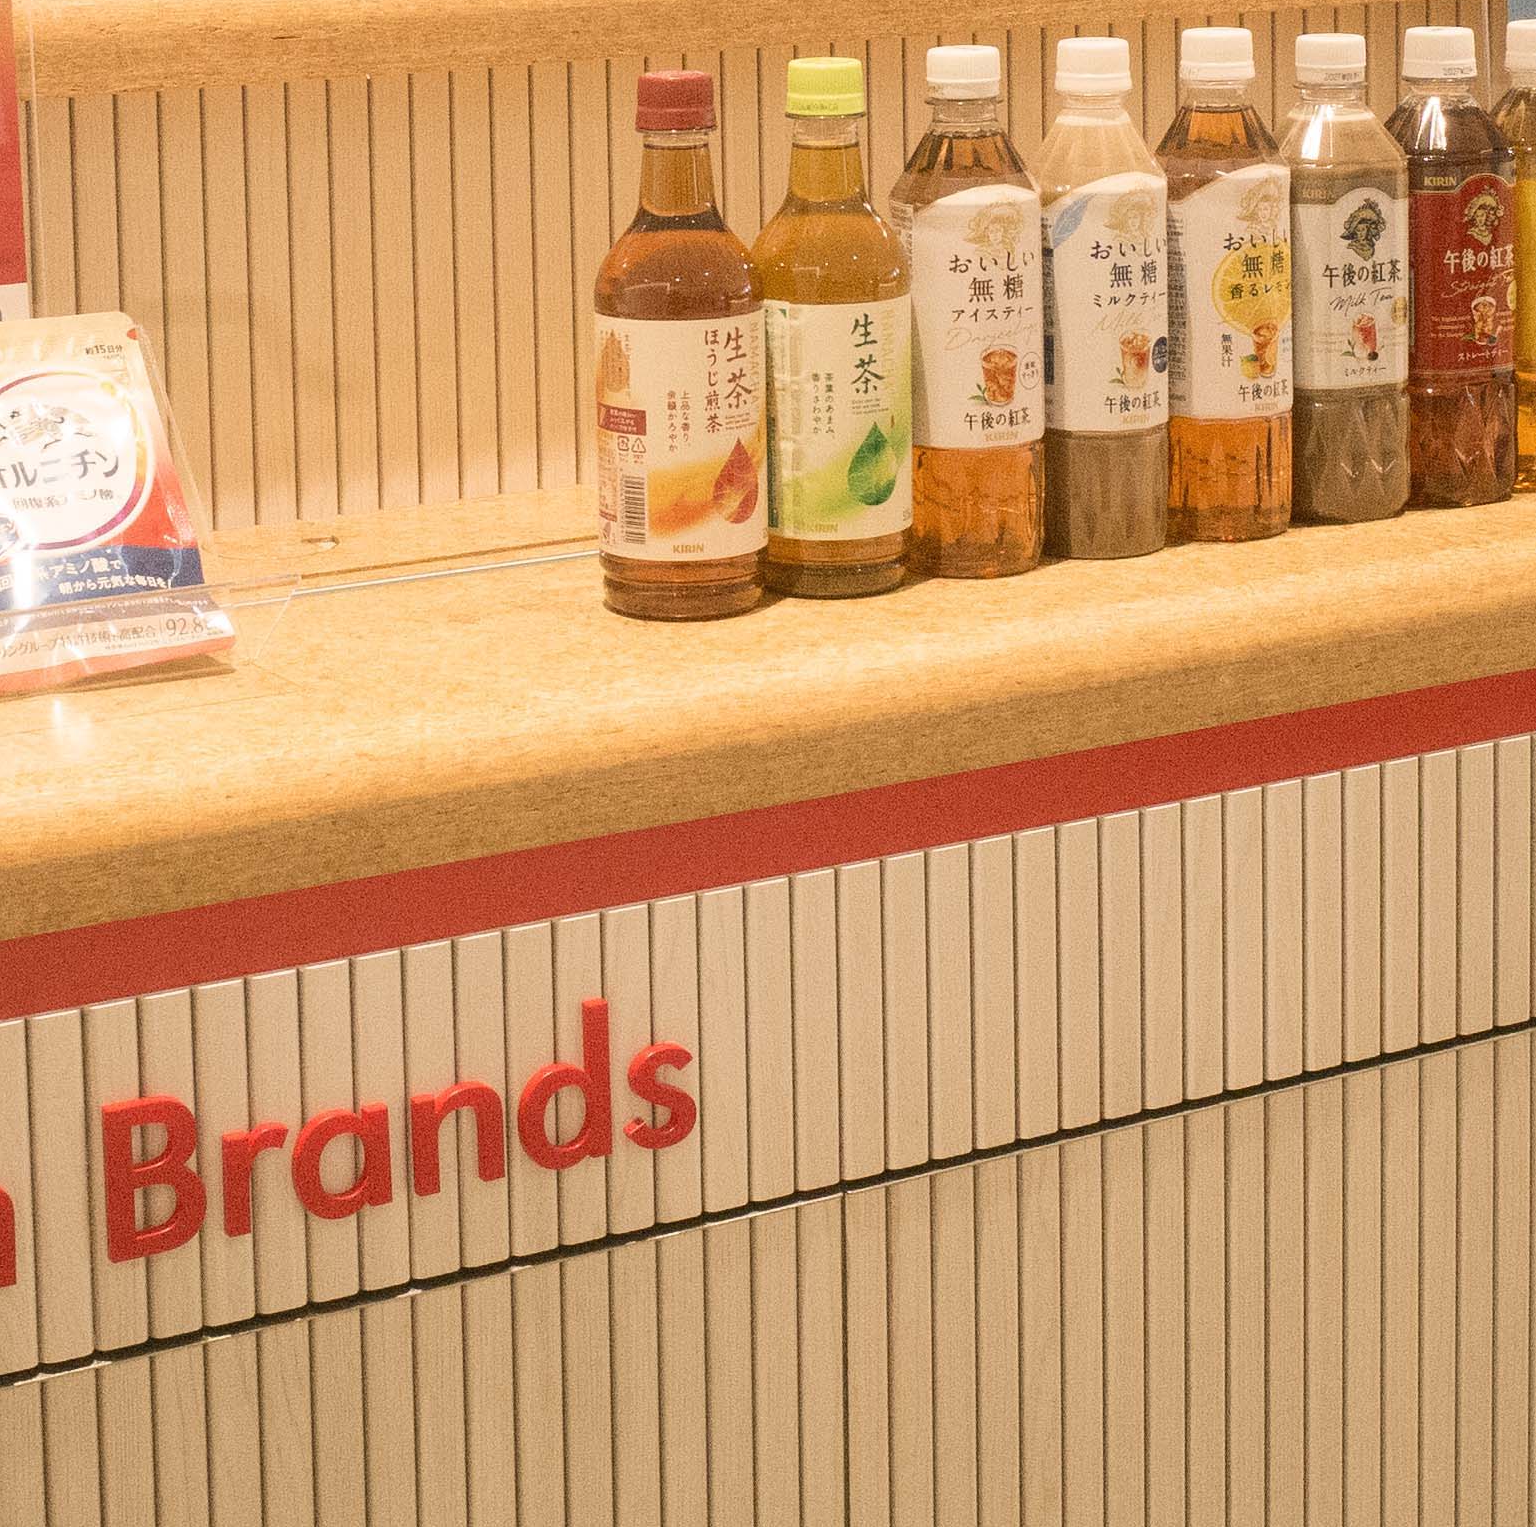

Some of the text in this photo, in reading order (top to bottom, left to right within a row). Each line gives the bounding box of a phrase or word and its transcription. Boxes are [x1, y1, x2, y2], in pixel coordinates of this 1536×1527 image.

[1423, 176, 1458, 187] KIRIN
[949, 250, 1035, 274] おいしい
[1109, 260, 1158, 289] 無糖
[1242, 249, 1285, 280] 無糖
[1322, 257, 1402, 290] 午後の紅茶
[968, 274, 1024, 303] 無糖
[1093, 292, 1167, 308] ミルクティー
[952, 305, 1034, 323] アイスティー
[851, 312, 886, 395] 生茶
[1220, 333, 1234, 369] 無果汁
[704, 328, 724, 434] ほうじ煎茶
[723, 325, 753, 411] 生茶
[1104, 391, 1163, 415] 午後の紅茶
[1238, 379, 1290, 403] 午後の紅茶
[963, 407, 1031, 431] 午後の紅茶
[672, 543, 705, 555] KIRIN
[100, 997, 699, 1266] Brands
